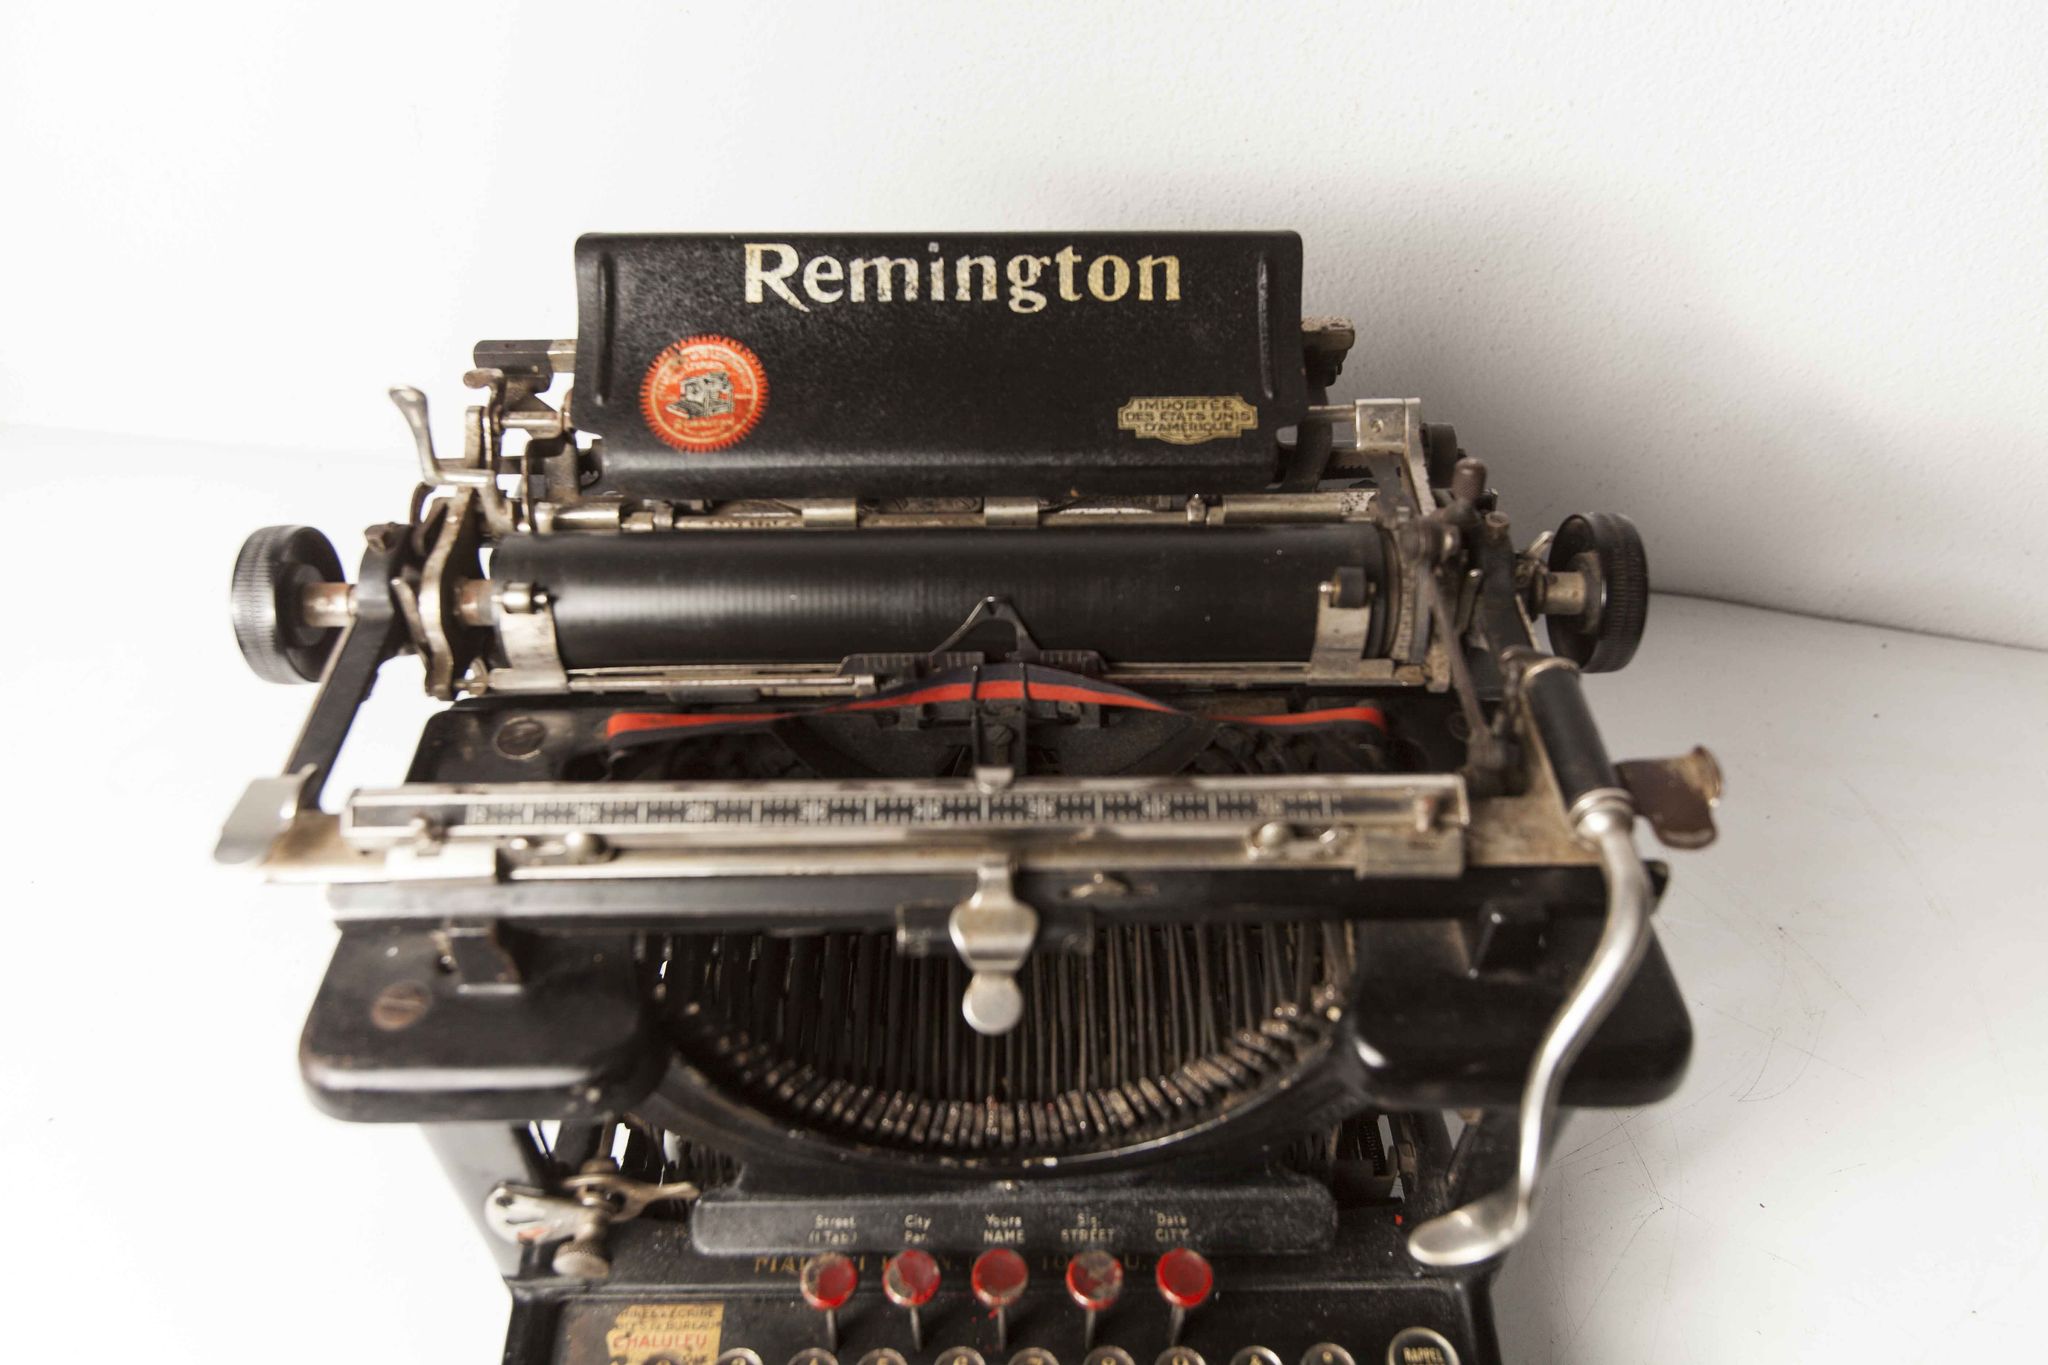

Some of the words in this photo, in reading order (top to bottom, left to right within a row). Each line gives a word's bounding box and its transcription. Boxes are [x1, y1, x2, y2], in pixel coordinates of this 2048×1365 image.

[744, 241, 1181, 313] Remington
[1126, 411, 1154, 421] DES
[1211, 411, 1250, 421] UNIS
[815, 1214, 856, 1229] Street
[904, 1213, 931, 1230] City
[985, 1213, 1022, 1227] Yours
[1156, 1212, 1188, 1226] Date
[983, 1229, 1025, 1243] NAME
[1061, 1229, 1115, 1242] STREET
[1155, 1228, 1189, 1242] CITY
